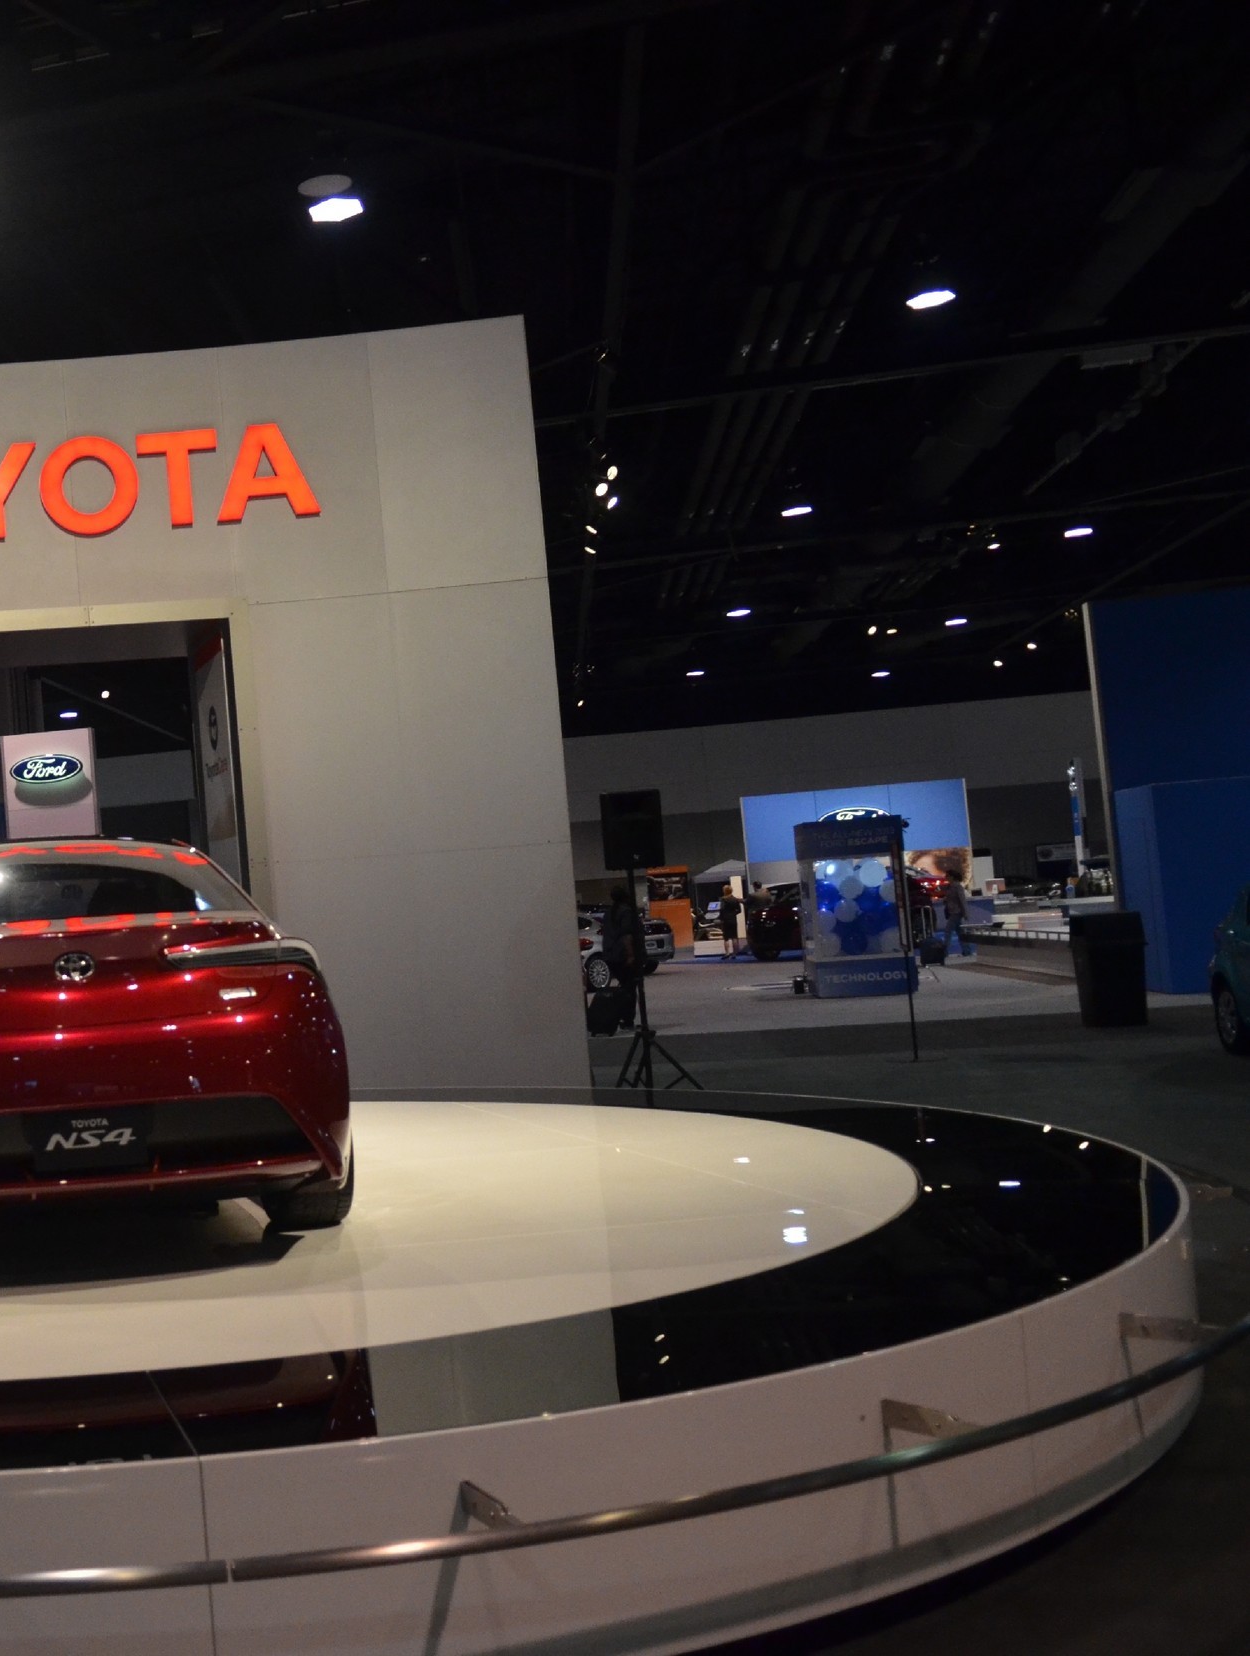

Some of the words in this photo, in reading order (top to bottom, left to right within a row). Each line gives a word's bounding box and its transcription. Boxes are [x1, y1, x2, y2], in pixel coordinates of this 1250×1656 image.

[22, 758, 68, 779] Ford
[847, 835, 889, 847] ESCAPE
[71, 1118, 109, 1128] TOYOTA
[45, 1127, 137, 1151] NS4
